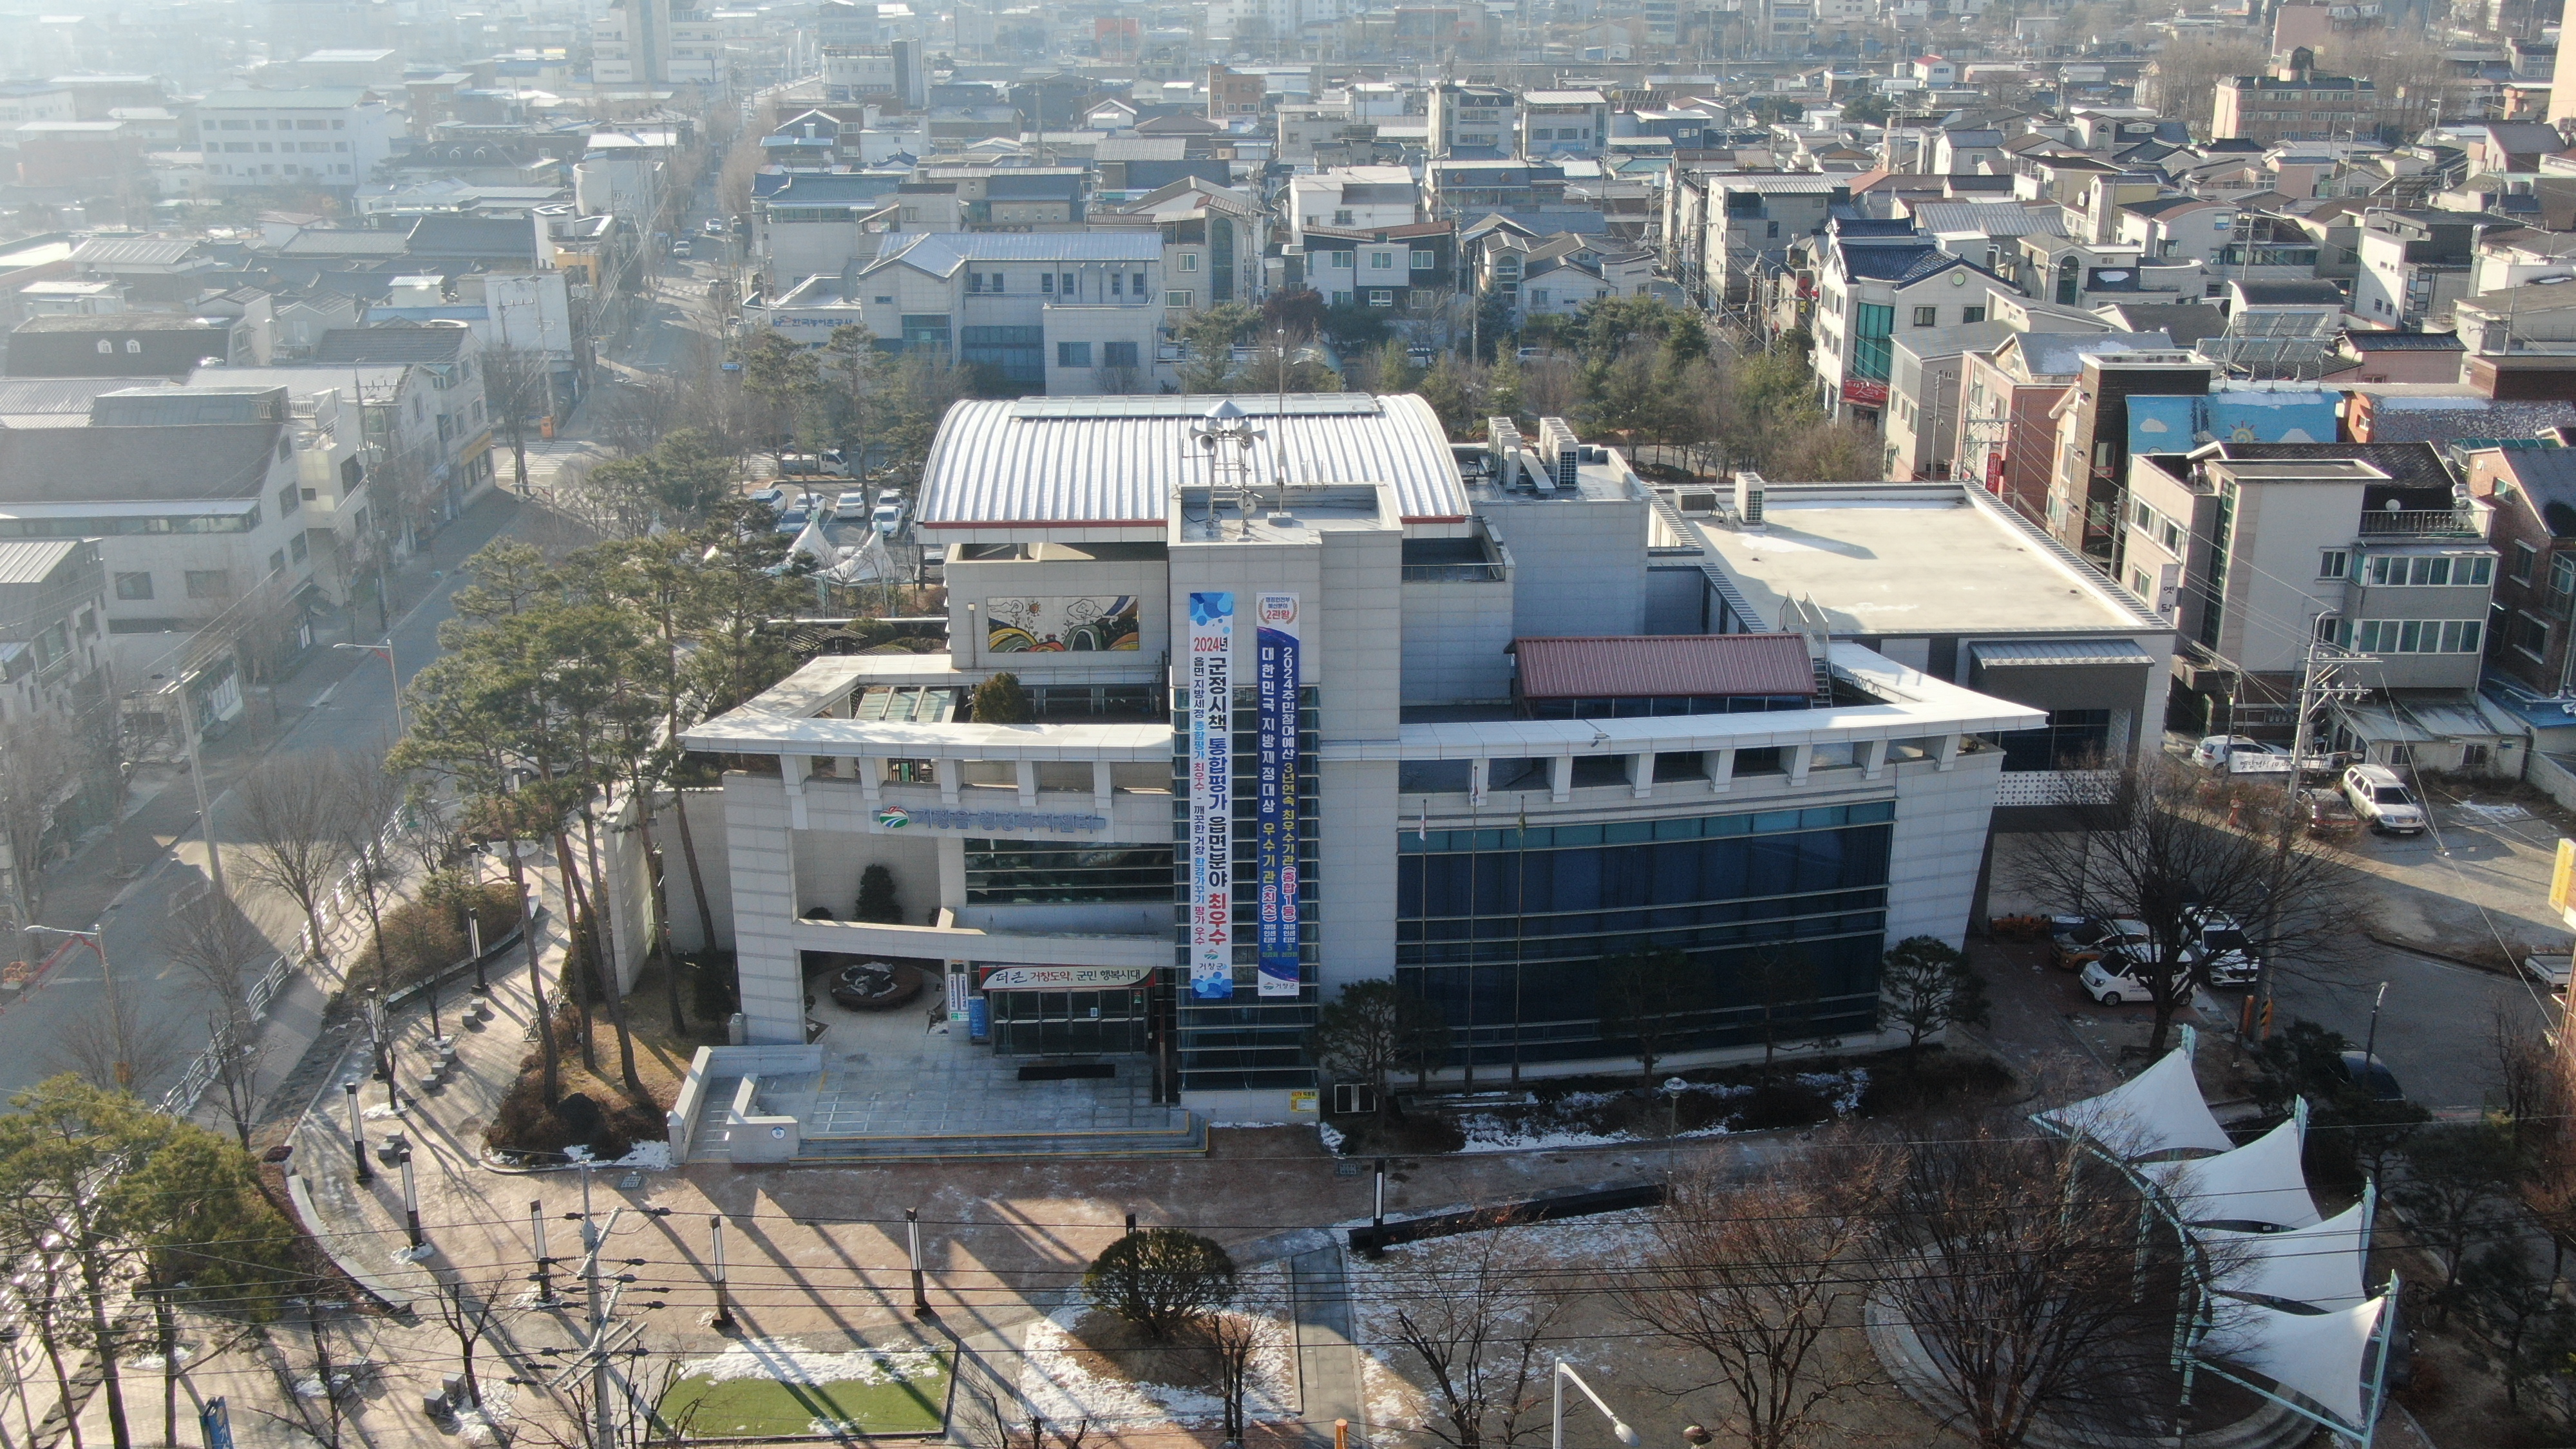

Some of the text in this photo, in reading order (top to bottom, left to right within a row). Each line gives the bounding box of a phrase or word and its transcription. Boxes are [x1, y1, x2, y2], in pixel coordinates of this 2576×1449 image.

[1266, 610, 1290, 620] 2관왕
[1194, 637, 1227, 652] 2024년
[1194, 657, 1204, 676] 읍면
[1262, 647, 1274, 712] 대한민국
[1194, 679, 1205, 719] 지방세정
[1282, 647, 1295, 760] 2024주민참여예산
[1194, 721, 1205, 759] 종합평가
[1194, 762, 1204, 791] 최우수
[1262, 717, 1275, 813] 지방재정대상
[1282, 762, 1294, 806] 3년연속
[1208, 658, 1227, 945] 군정시책 통합평가 읍면분야 최우수
[914, 808, 1094, 835] 거창읍 행정복지센터
[1194, 806, 1205, 833] 깨끗한
[1195, 837, 1205, 855] 거창
[1195, 857, 1205, 904] 환경가꾸기
[1195, 907, 1205, 924] 평가
[1195, 927, 1205, 945] 우수
[996, 969, 1141, 983] 더 큰 거창도약, 군민 행복시대
